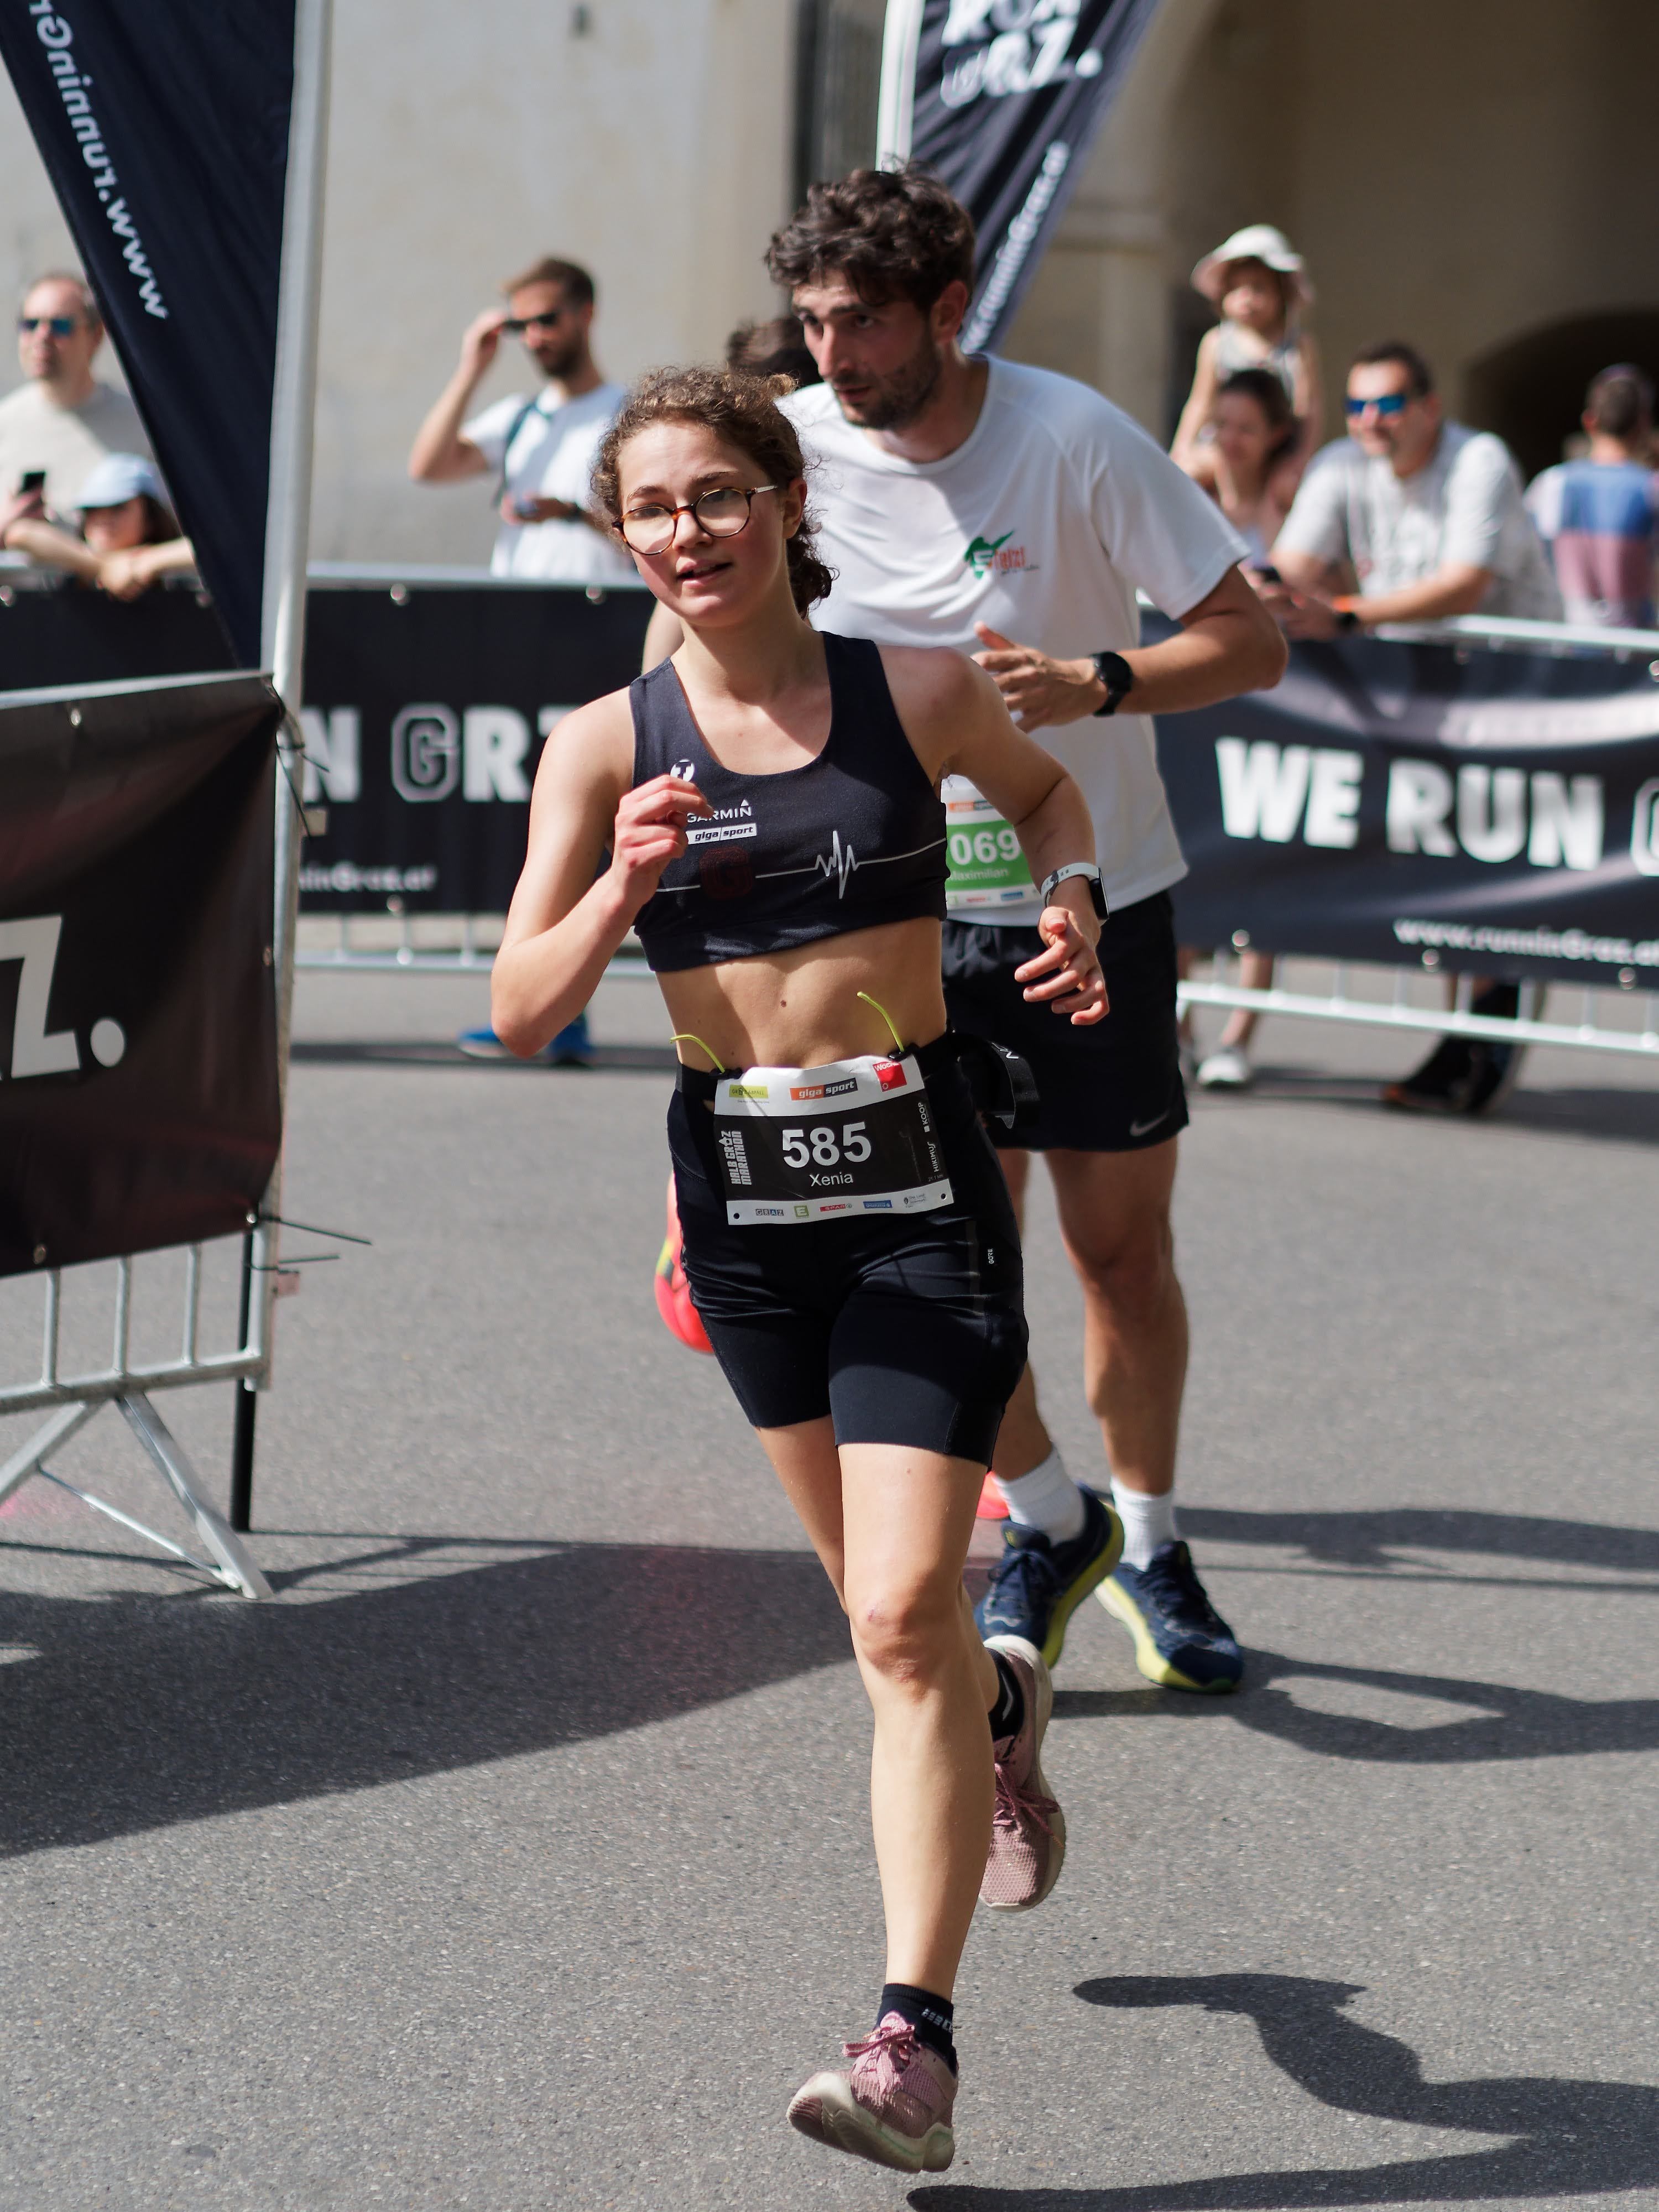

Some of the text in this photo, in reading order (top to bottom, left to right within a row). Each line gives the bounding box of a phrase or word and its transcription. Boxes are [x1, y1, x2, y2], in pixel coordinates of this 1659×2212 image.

[1215, 736, 1363, 849] WE
[1386, 758, 1604, 871] RUN
[695, 826, 753, 842] giga sport
[950, 829, 1021, 865] 069
[799, 1081, 854, 1099] giga sport
[918, 1102, 928, 1125] KOOP
[782, 1121, 871, 1168] 585
[731, 1131, 752, 1185] MARATHON
[726, 1161, 742, 1185] HALB
[810, 1171, 853, 1187] Xenia
